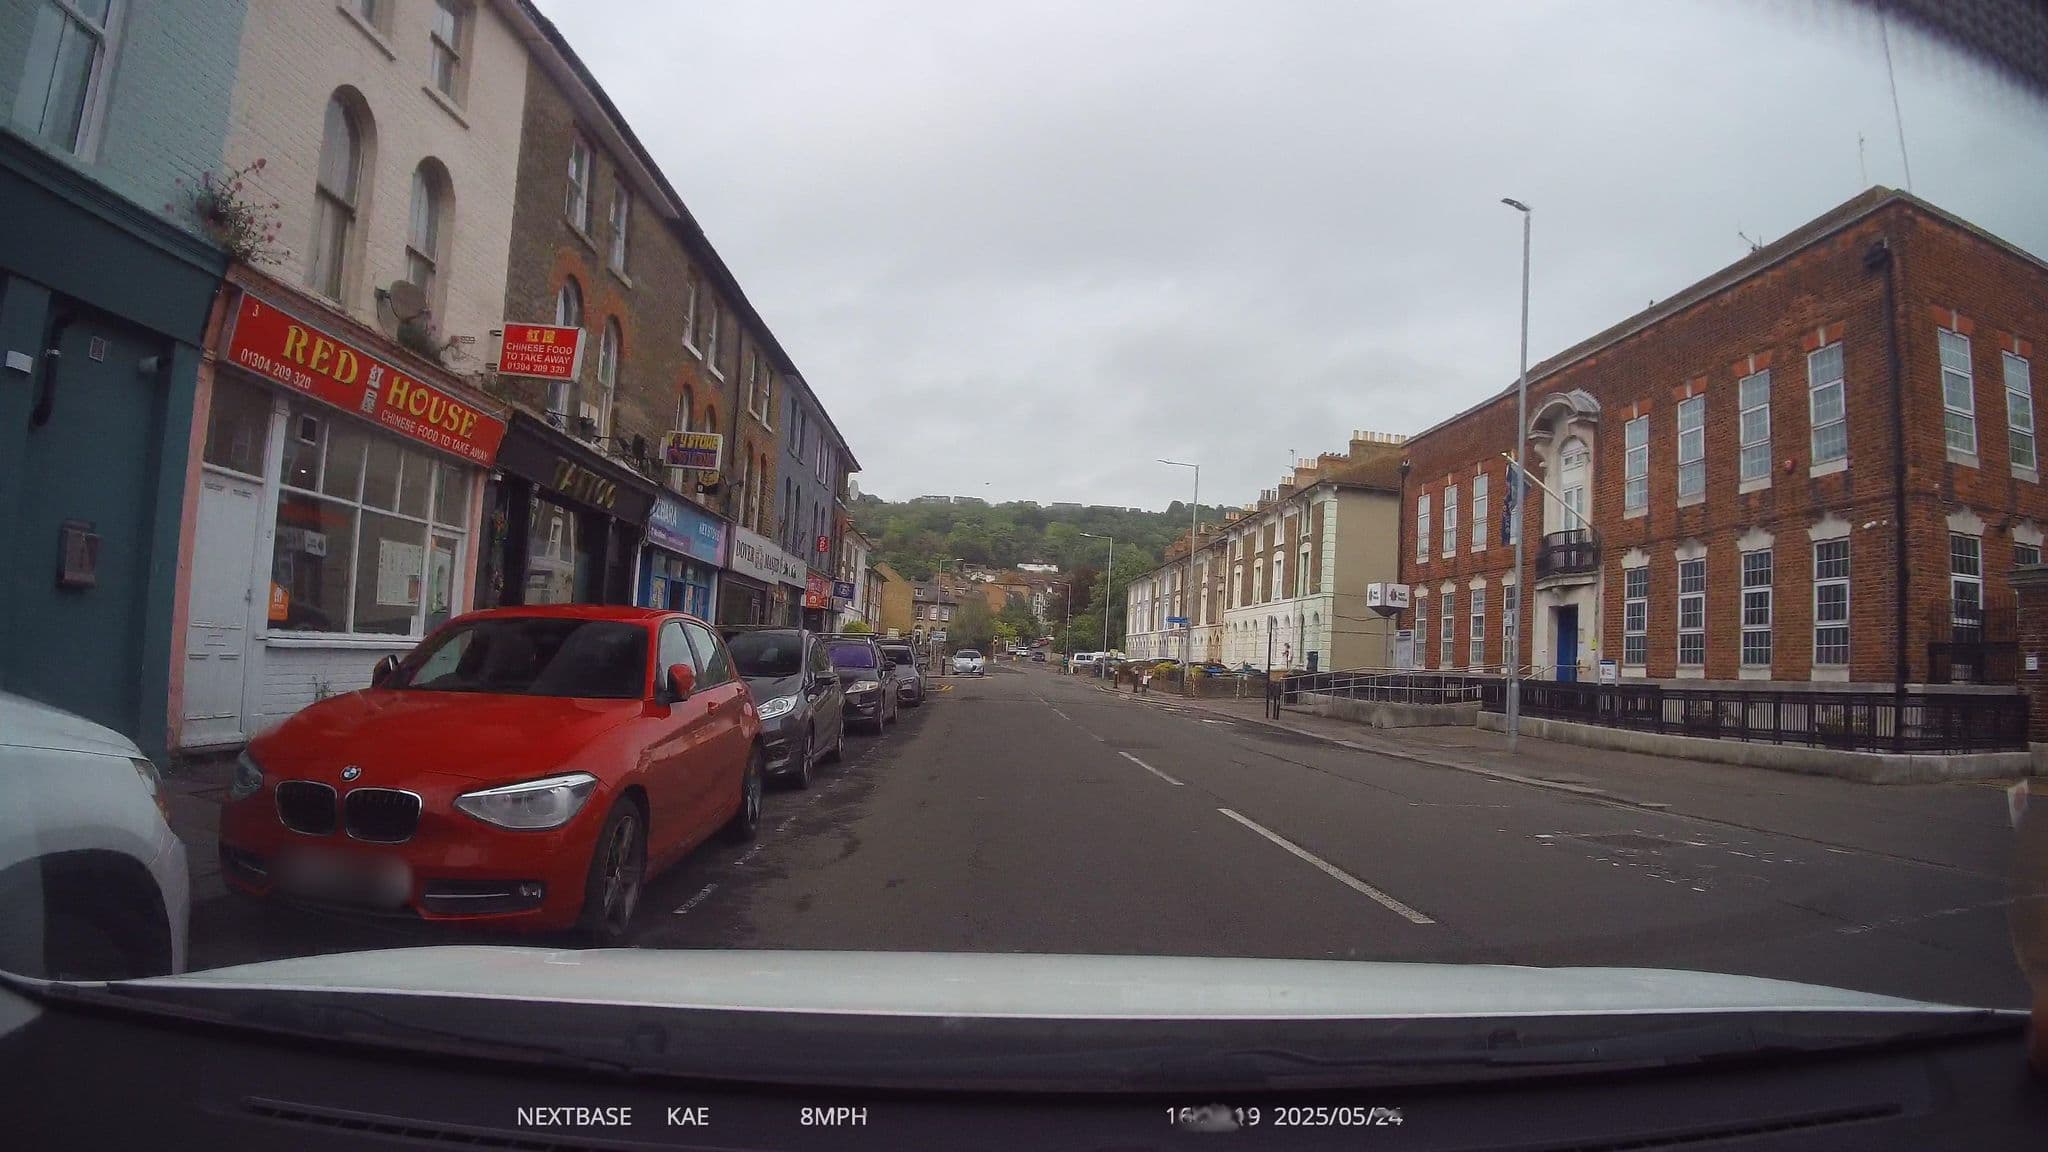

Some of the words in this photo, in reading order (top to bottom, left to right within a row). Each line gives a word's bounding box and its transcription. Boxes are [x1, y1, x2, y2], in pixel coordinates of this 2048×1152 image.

[252, 304, 260, 318] 3
[506, 343, 545, 353] CHINESE
[546, 345, 573, 355] FOOD
[506, 351, 518, 361] TO
[520, 353, 543, 363] TAKE
[544, 355, 570, 365] AWAY
[240, 348, 270, 373] 01304
[272, 362, 292, 380] 209
[293, 371, 312, 389] 320
[507, 362, 531, 371] 01304
[533, 364, 548, 373] 209
[550, 365, 565, 374] 320
[281, 325, 359, 385] RED
[386, 376, 479, 439] HOUSE
[381, 409, 416, 433] CHINESE
[417, 423, 439, 442] FOOD
[440, 434, 451, 447] TO
[452, 439, 470, 456] TAKE
[469, 446, 489, 462] AWAY
